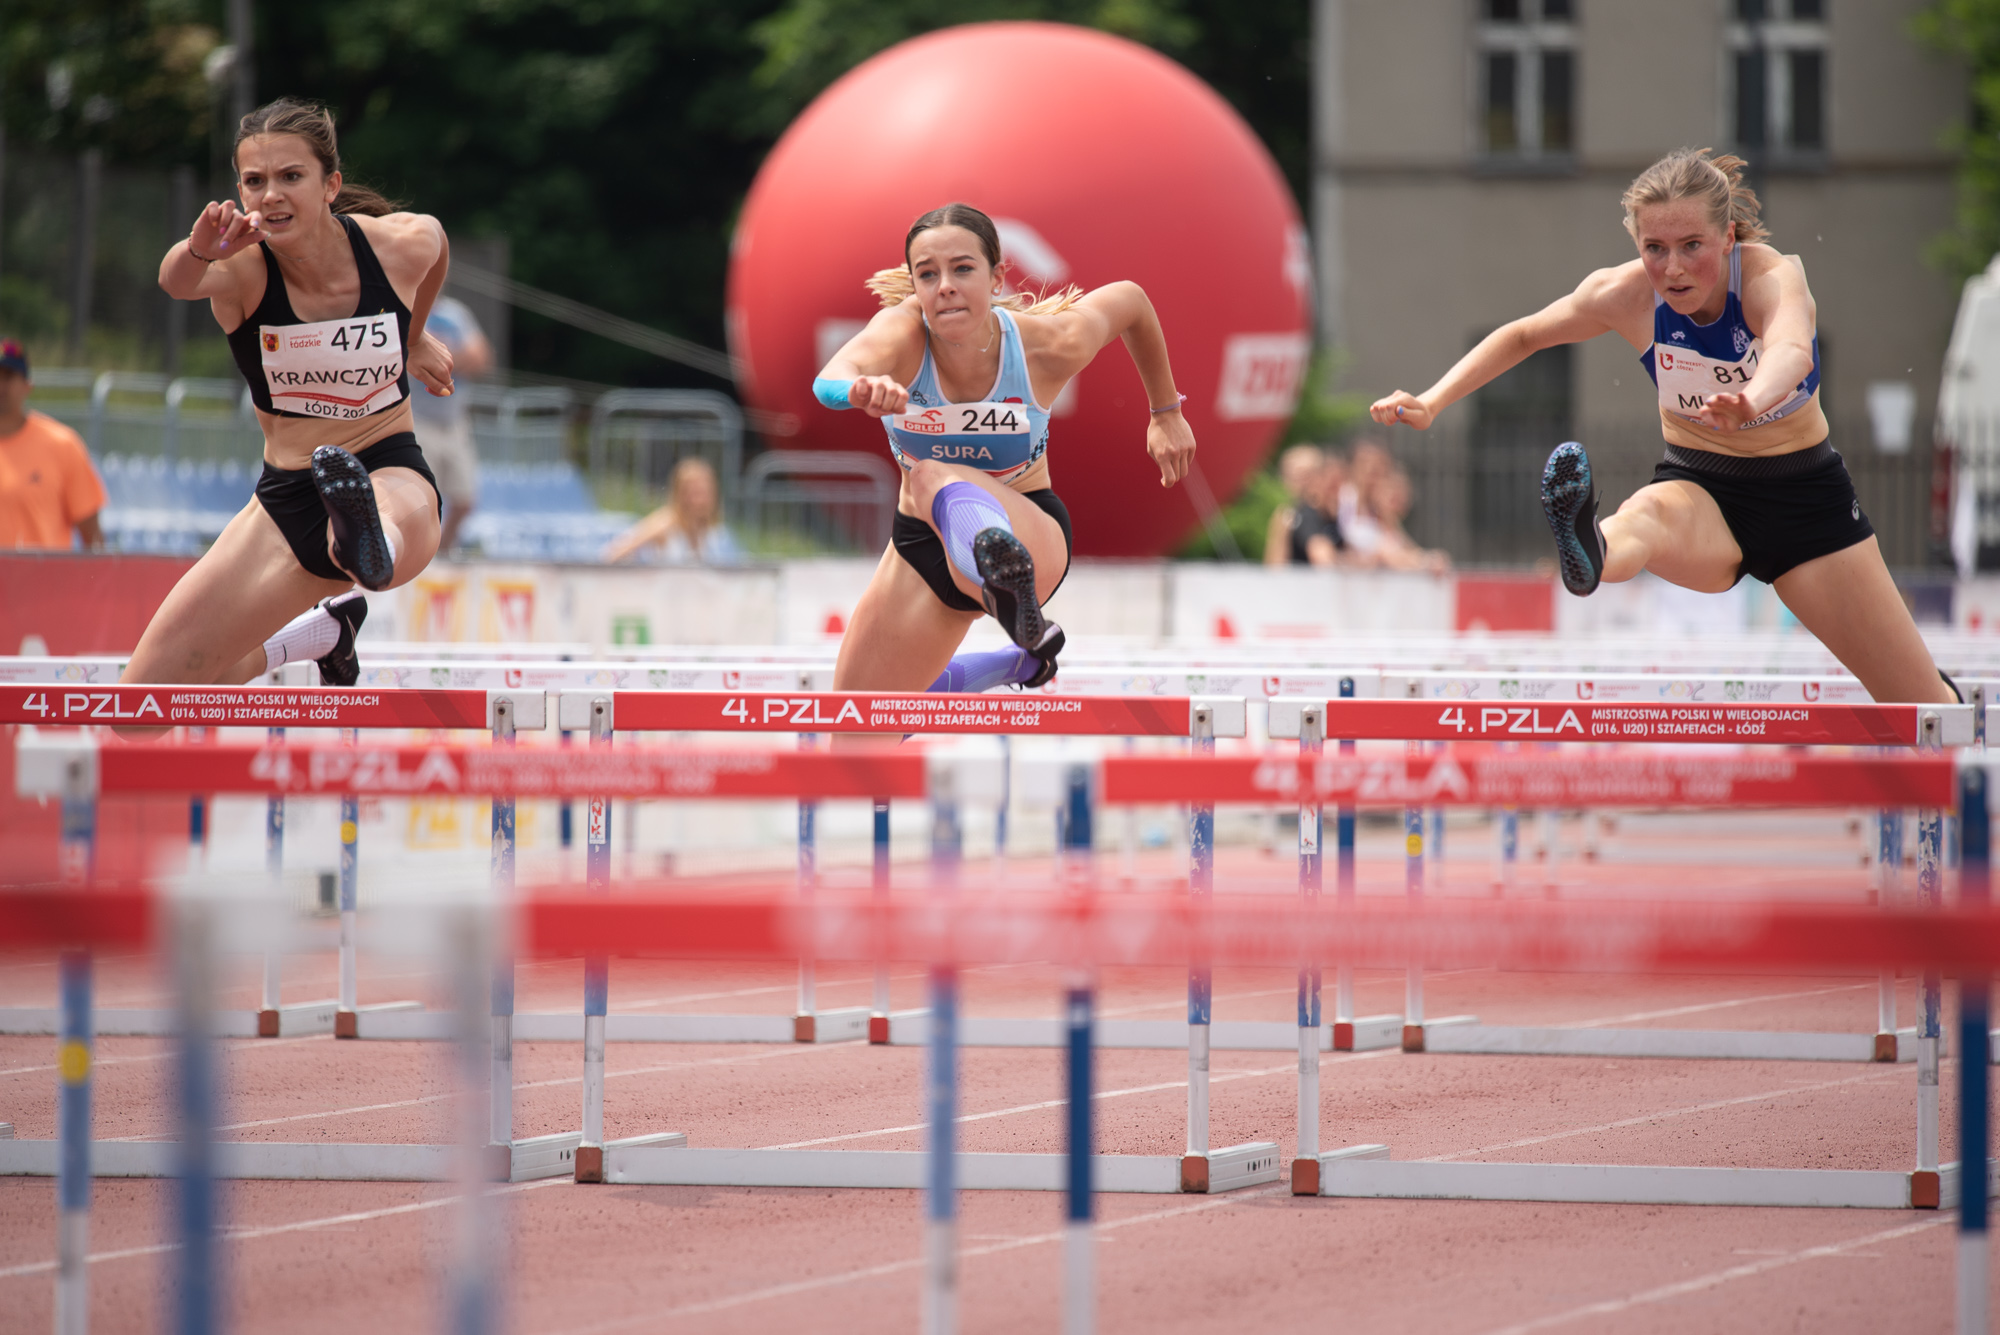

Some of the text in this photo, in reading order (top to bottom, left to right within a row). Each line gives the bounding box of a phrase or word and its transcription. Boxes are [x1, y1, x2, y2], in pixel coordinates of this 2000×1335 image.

[290, 339, 321, 349] łódzkie
[330, 322, 388, 351] 475
[271, 363, 398, 387] KRAWCZYK
[304, 401, 370, 419] ŁÓDŹ 2021
[906, 422, 943, 432] ORLEN
[961, 409, 1019, 432] 244
[931, 445, 994, 460] SURA
[170, 694, 380, 706] MISTRZOSTWA POLSKI W WIELOBOJACH
[870, 699, 1082, 713] MISTRZOSTWA POLSKI W WIELOBOJACH
[170, 707, 198, 721] (U16,
[201, 707, 226, 720] U20)
[228, 709, 232, 719] I
[234, 708, 299, 719] SZTAFETACH
[309, 706, 338, 720] ŁÓDŹ
[870, 713, 899, 726] (U16,
[901, 714, 926, 727] U20)
[928, 715, 932, 725] I
[934, 714, 1000, 726] SZTAFETACH
[1010, 712, 1041, 726] ŁÓDŹ
[1591, 709, 1809, 721] MISTRZOSTWA POLSKI W WIELOBOJACH
[1591, 723, 1620, 737] (U16,
[1623, 723, 1649, 737] U20)
[1651, 724, 1655, 734] I
[1657, 723, 1725, 735] SZTAFETACH
[1736, 721, 1766, 735] ŁÓDŹ
